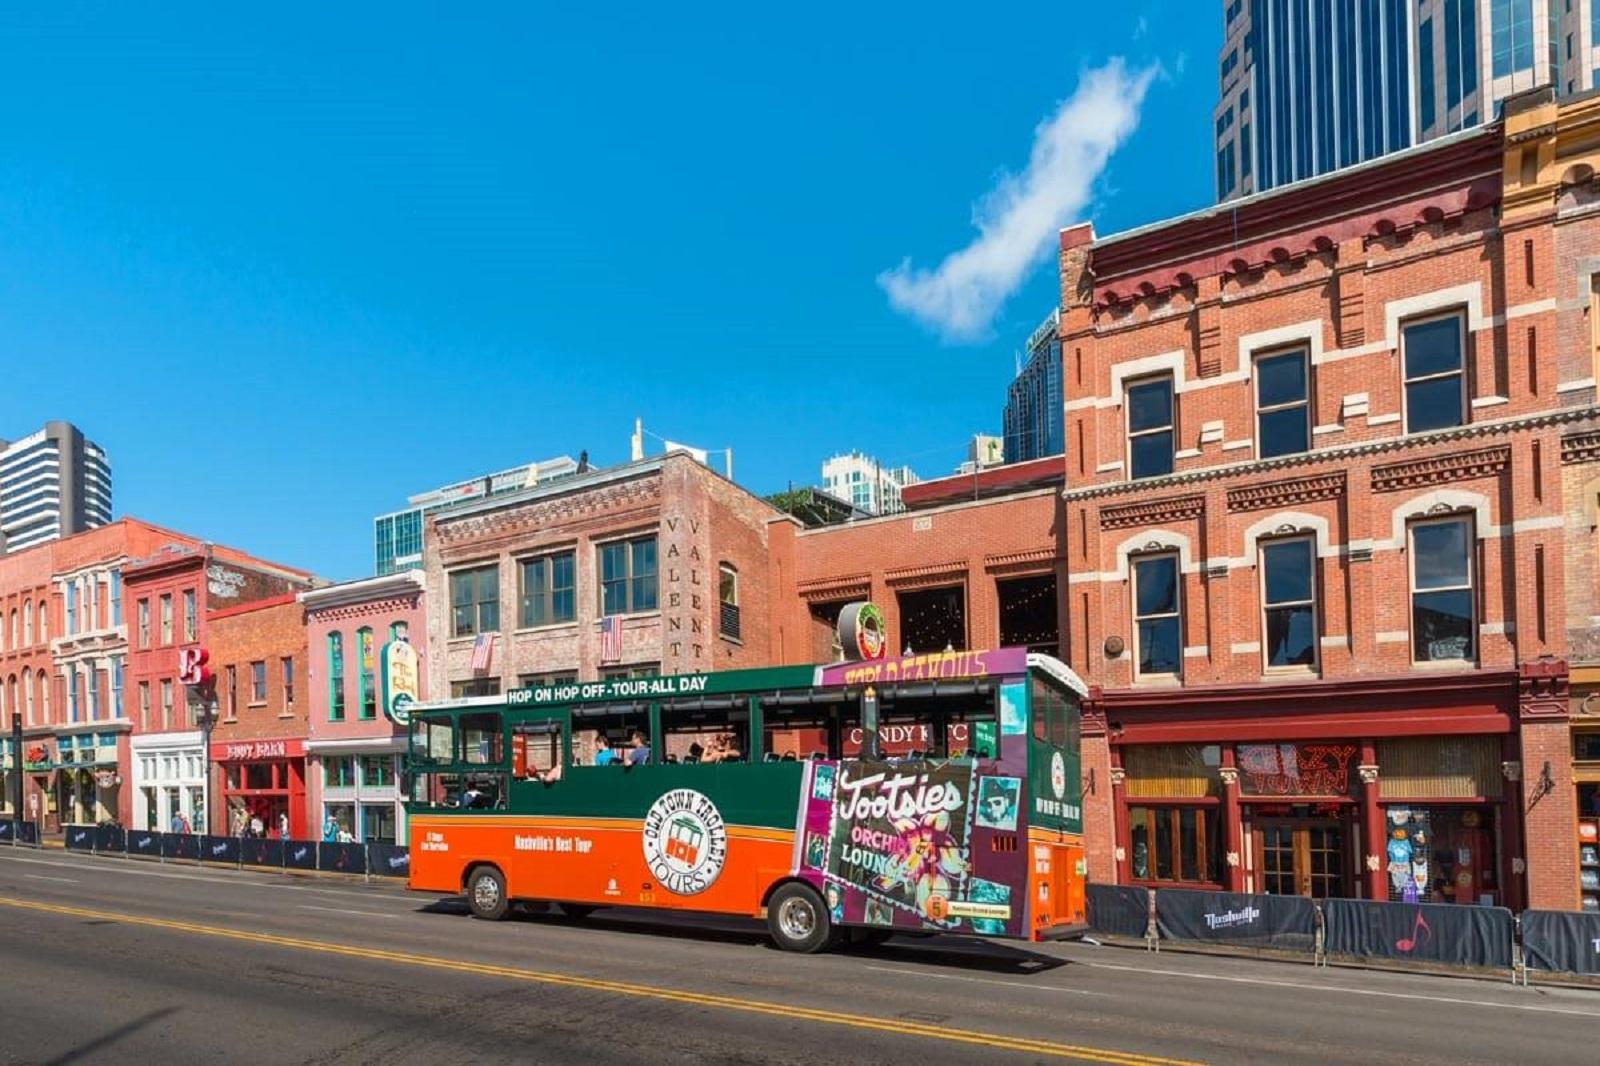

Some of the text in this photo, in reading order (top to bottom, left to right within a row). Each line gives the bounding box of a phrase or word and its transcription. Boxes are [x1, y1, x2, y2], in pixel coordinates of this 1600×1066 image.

[902, 649, 990, 681] FAMOUS
[508, 690, 532, 704] HOP
[534, 688, 551, 702] ON
[554, 686, 577, 701] HOP
[680, 676, 708, 690] DAY
[851, 725, 914, 745] CNDY
[839, 769, 964, 819] Tootsies
[645, 791, 725, 869] OLD TOWN TROLLEY
[649, 849, 706, 893] TOURS
[932, 901, 941, 917] 5
[1204, 906, 1260, 930] Nashville
